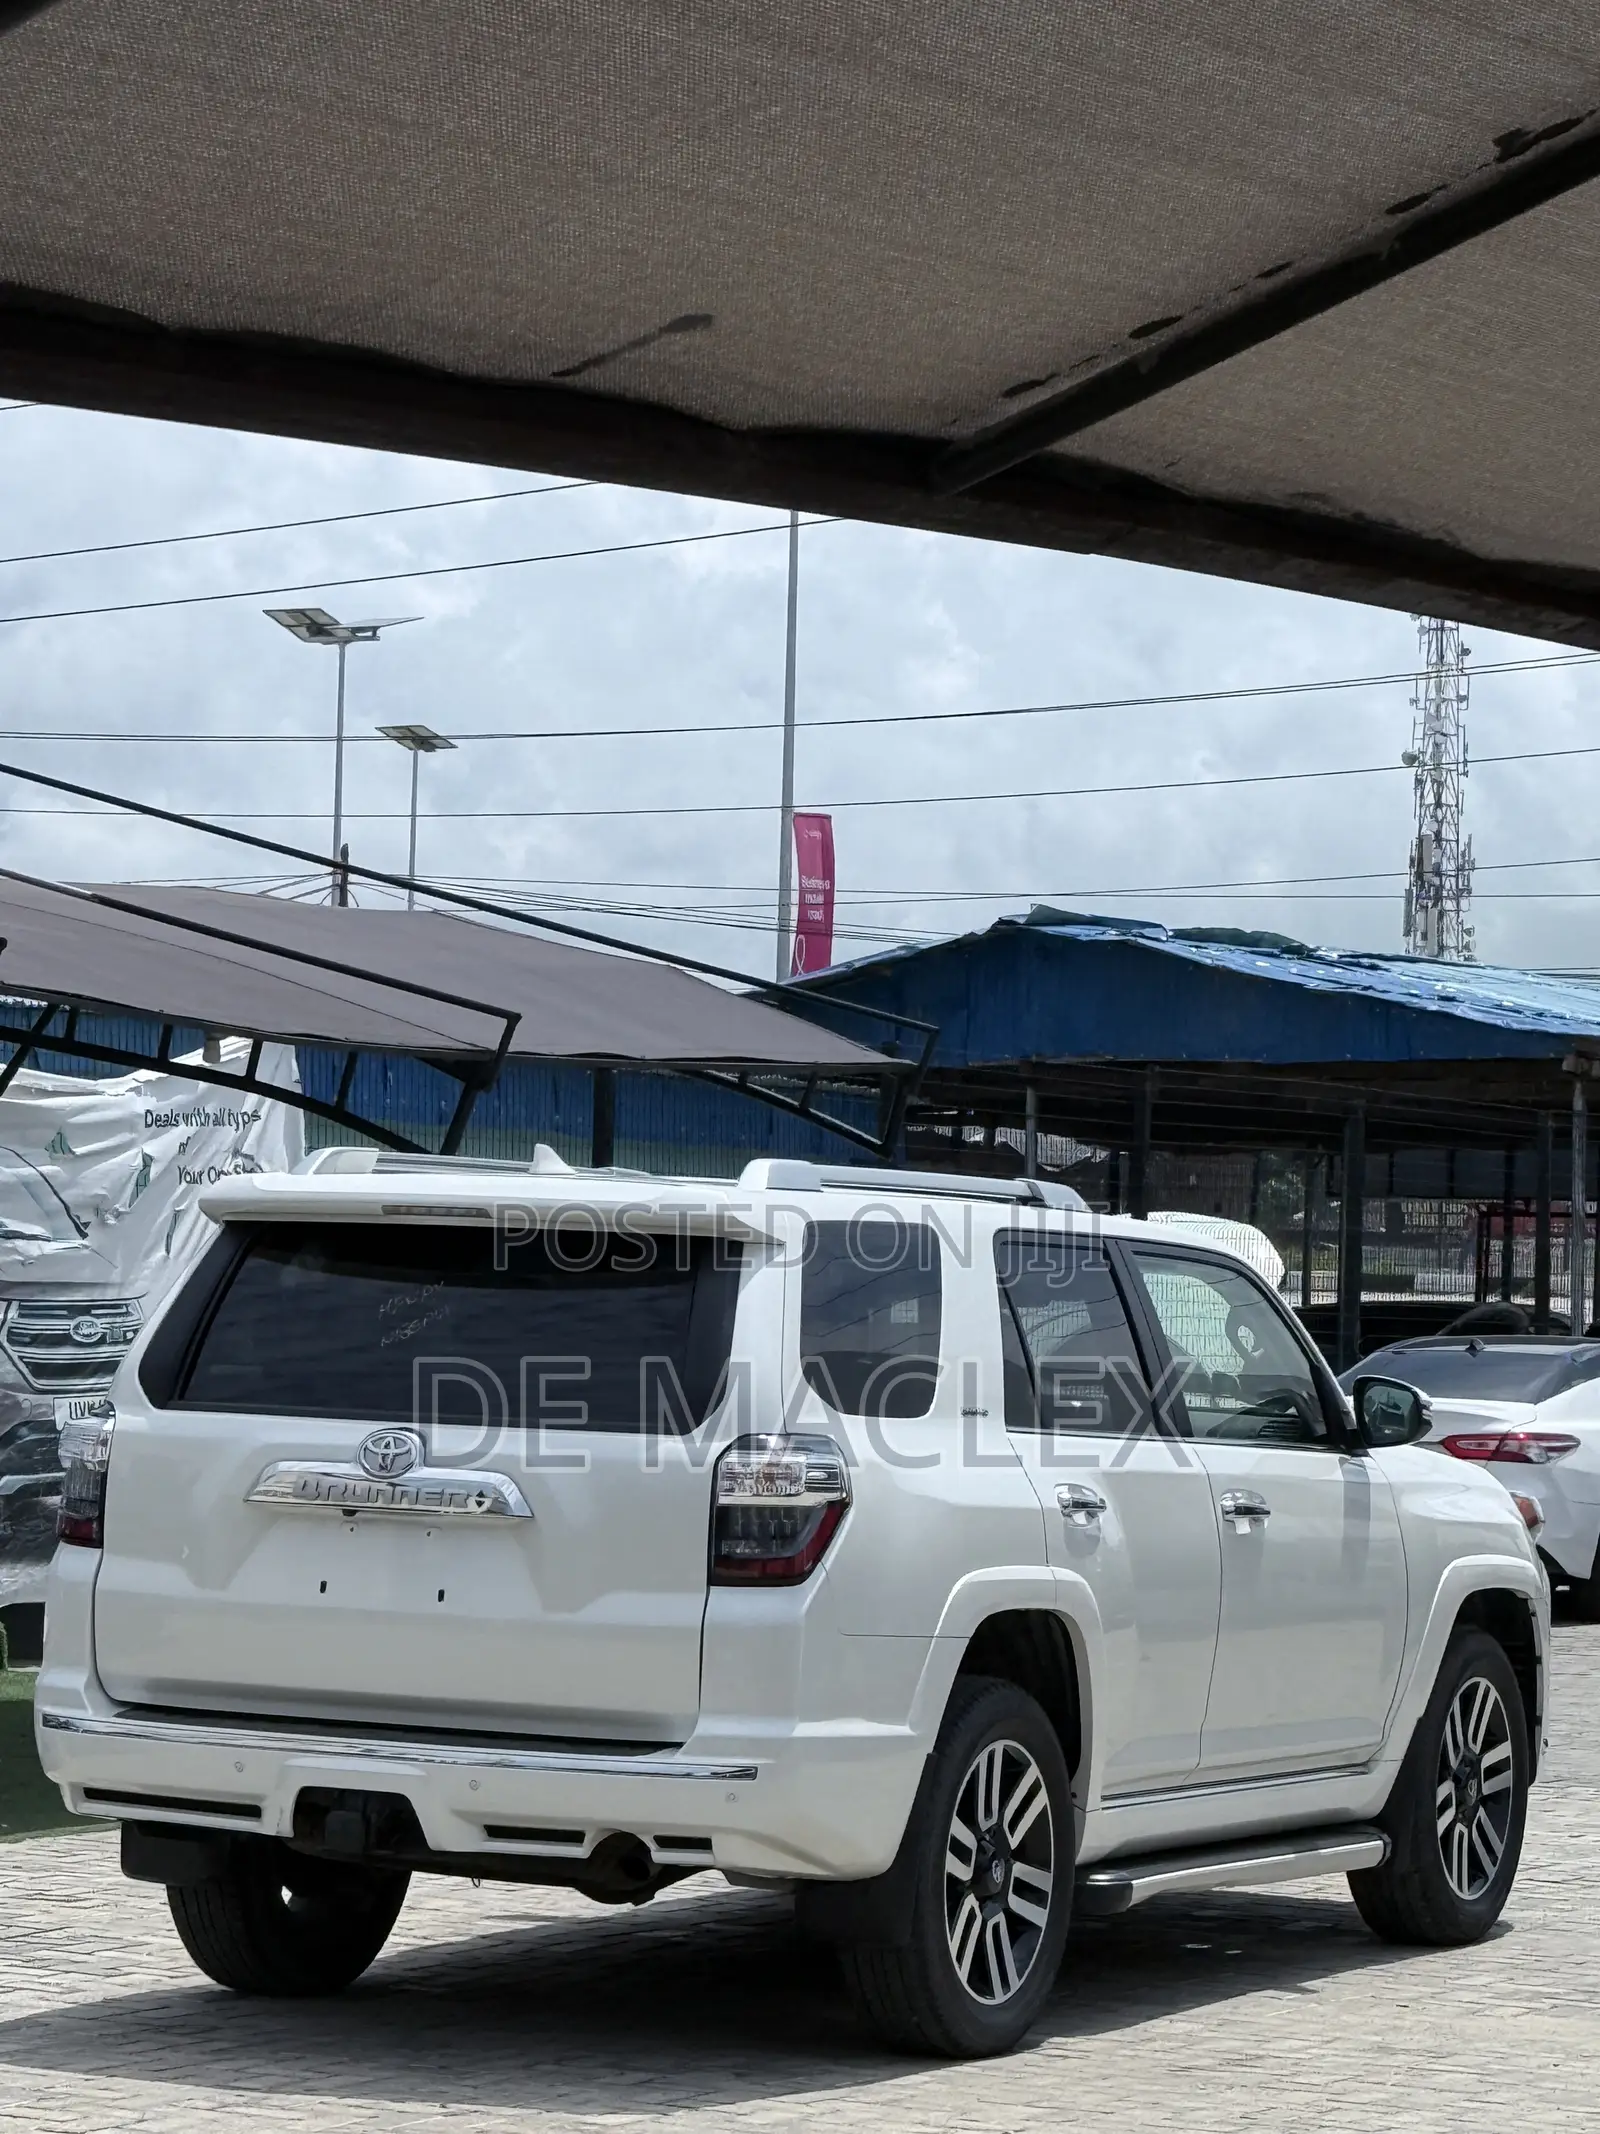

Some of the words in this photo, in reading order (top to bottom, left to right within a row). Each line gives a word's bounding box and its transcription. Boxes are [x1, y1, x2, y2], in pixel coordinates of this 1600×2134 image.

[144, 1108, 181, 1128] Deals
[182, 1106, 211, 1127] with
[212, 1107, 226, 1128] all
[177, 1165, 205, 1185] Your
